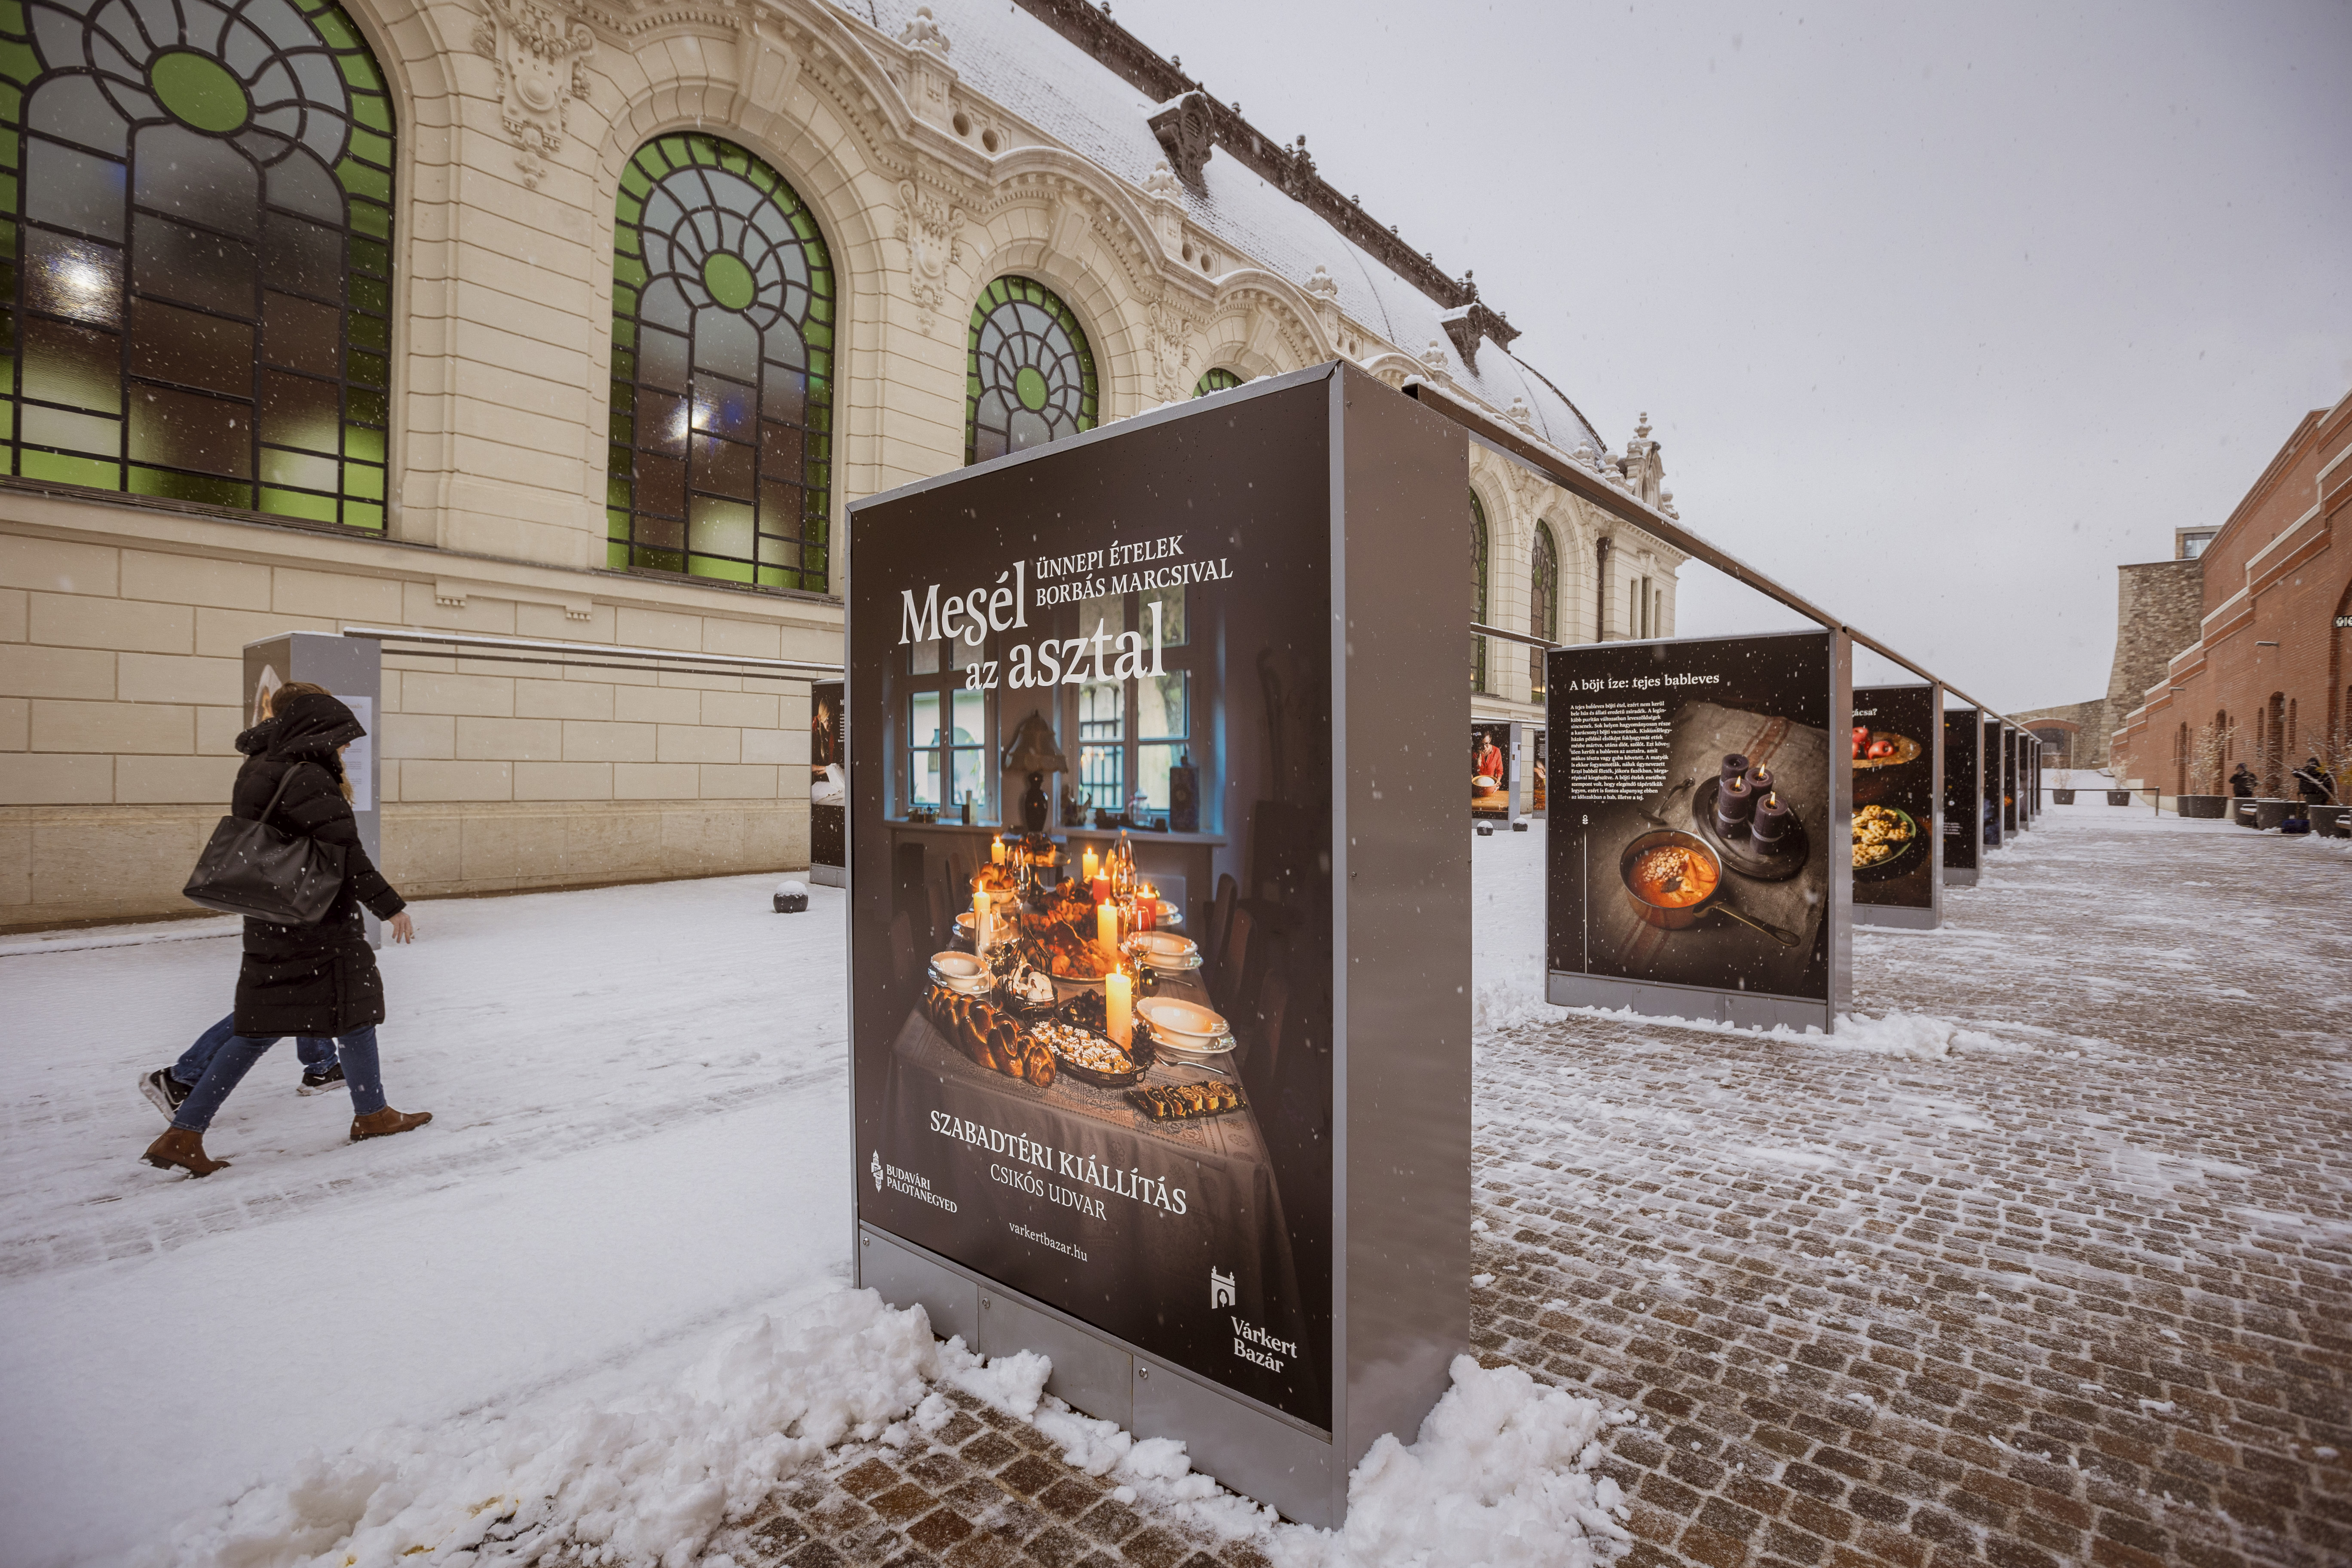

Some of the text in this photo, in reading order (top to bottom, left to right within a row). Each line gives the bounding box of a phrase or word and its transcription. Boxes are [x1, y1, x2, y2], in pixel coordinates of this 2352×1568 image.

[1036, 535, 1184, 579] ÜNNEPI ÉTELEK
[898, 560, 1028, 647] Mesél
[1036, 558, 1233, 606] BORBÁS MARCSIVAL
[965, 601, 1167, 691] az asztal
[1570, 673, 1719, 692] A böjt íze: tejes bableves
[886, 1164, 930, 1190] BUDAVÁRI
[930, 1110, 1187, 1215] SZABADTÉRI KIÁLLÍTÁS
[886, 1176, 957, 1213] PALOTANEGYED
[990, 1163, 1106, 1221] CSIKÓS UDVAR
[1008, 1221, 1087, 1262] varkertbazar.hu
[1230, 1316, 1298, 1358] Várkert
[1233, 1338, 1283, 1373] Bazár
